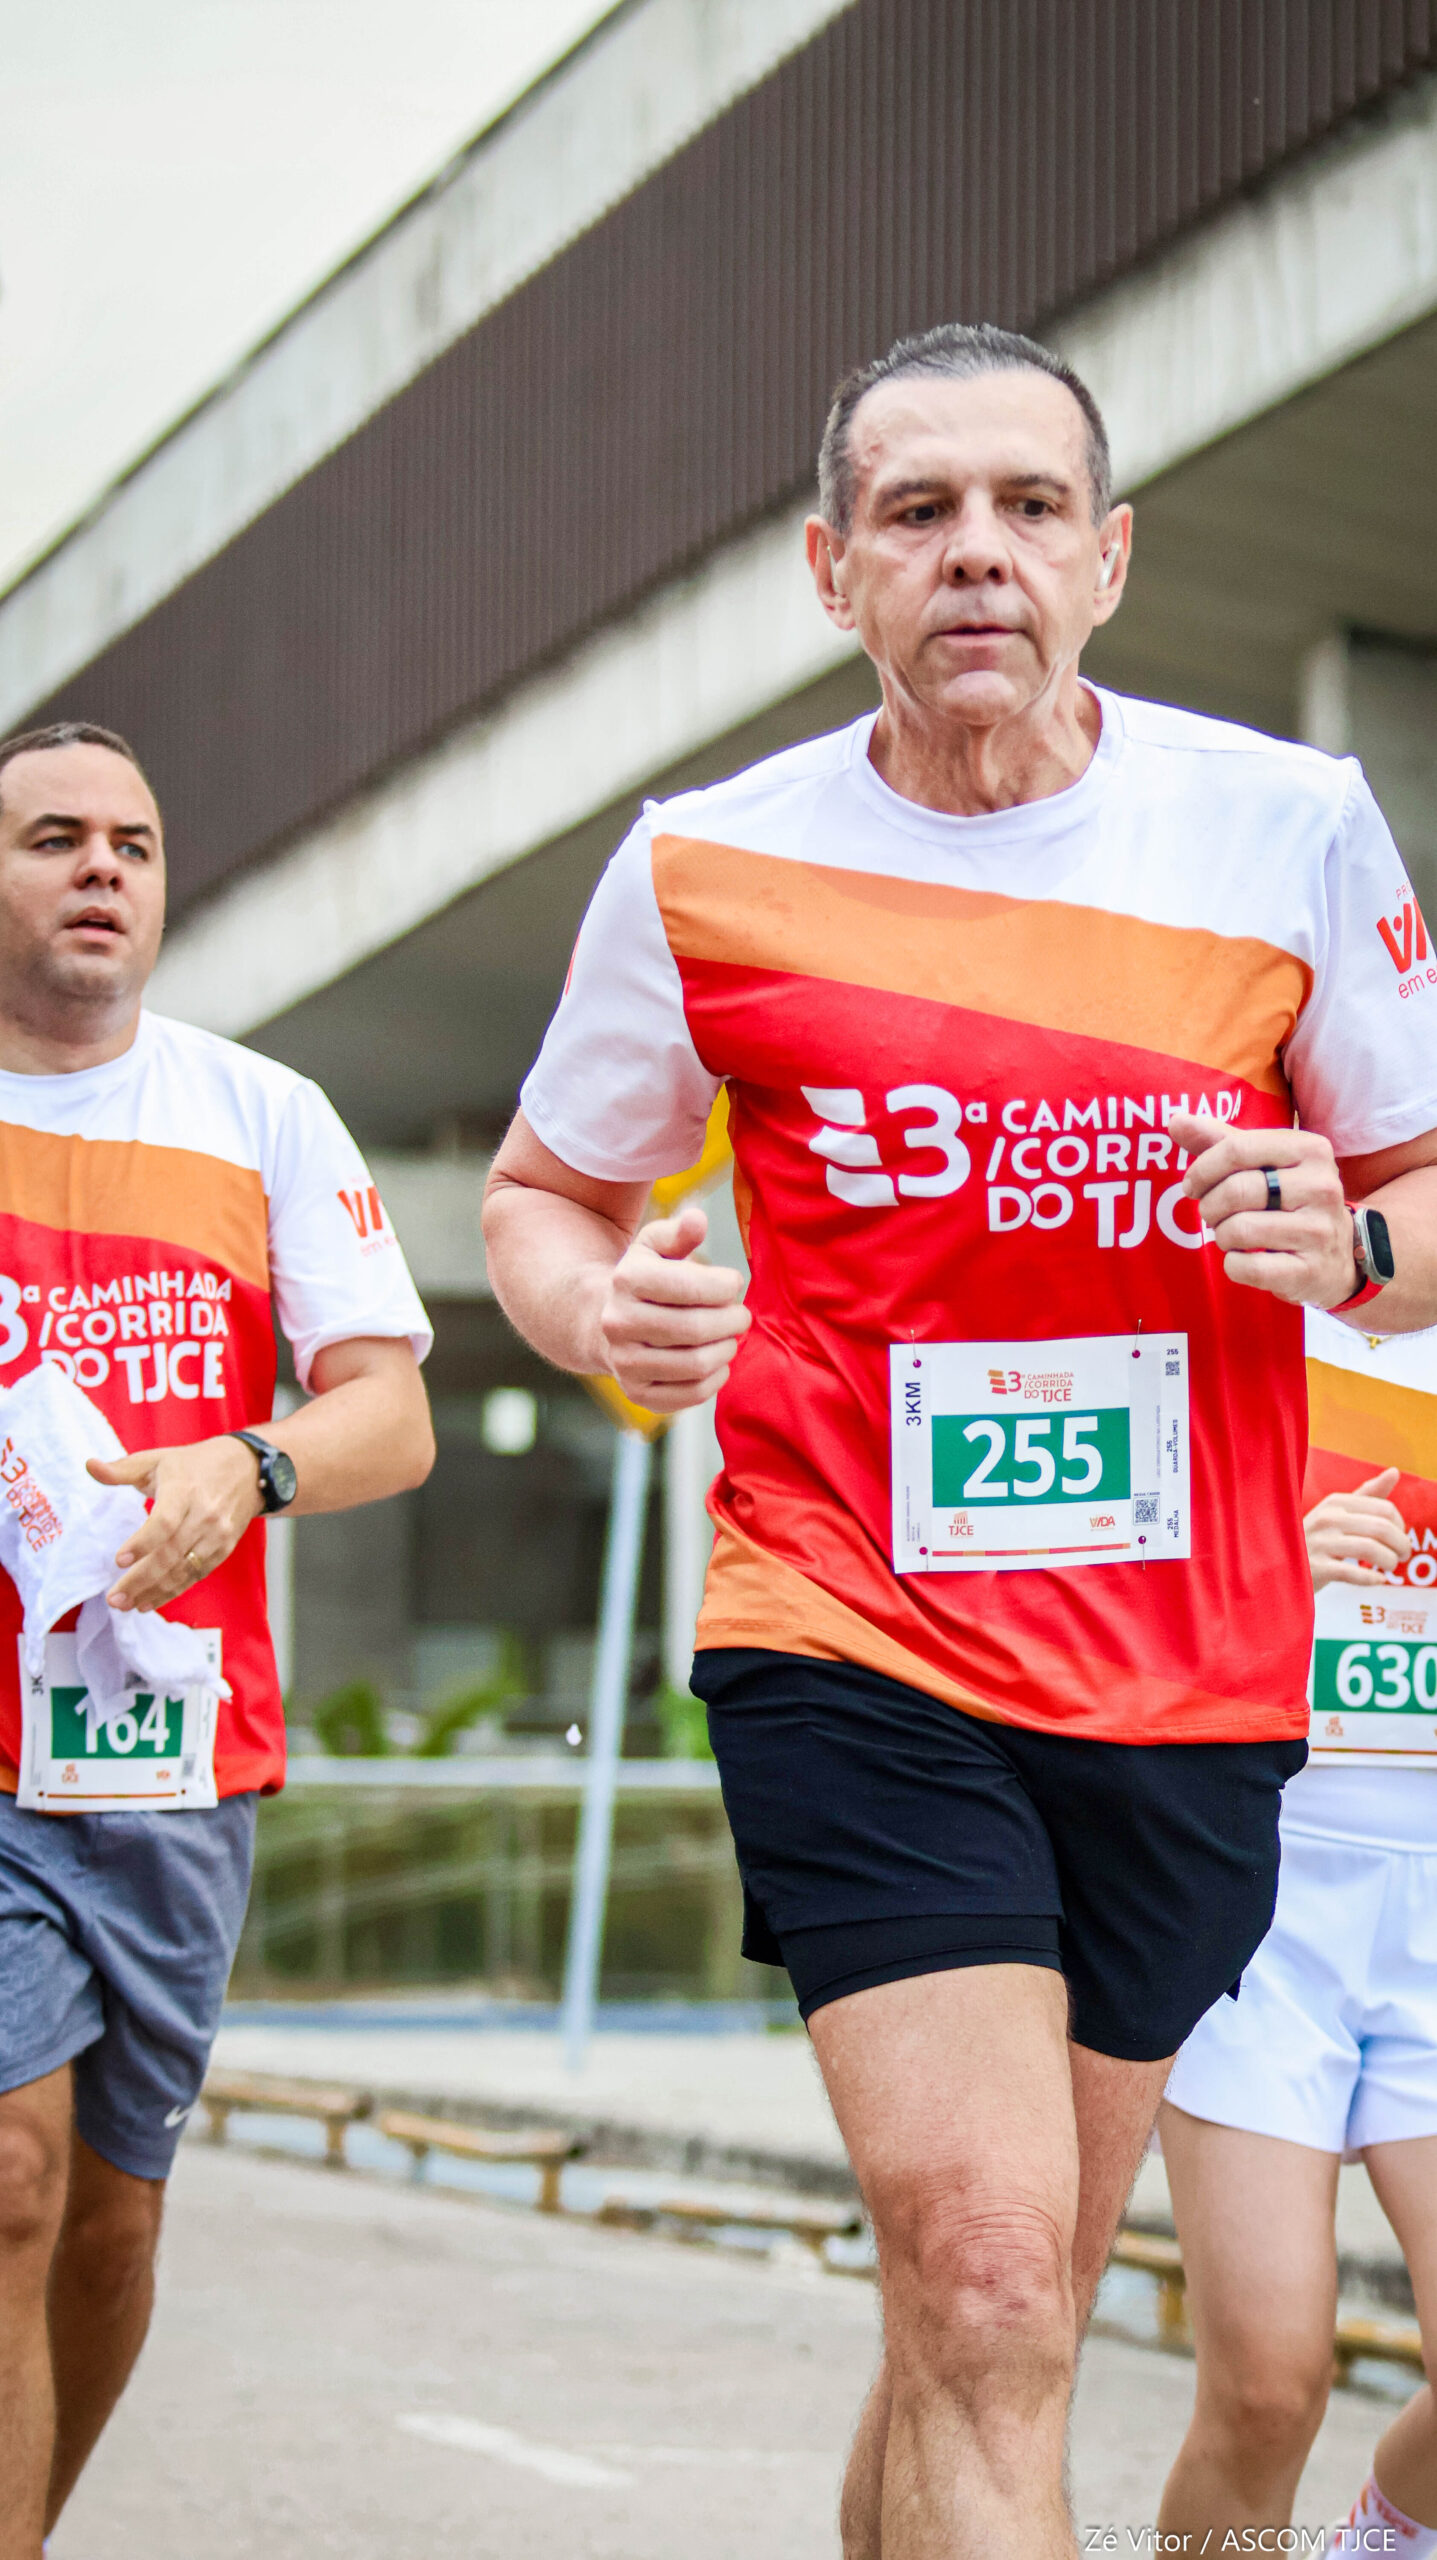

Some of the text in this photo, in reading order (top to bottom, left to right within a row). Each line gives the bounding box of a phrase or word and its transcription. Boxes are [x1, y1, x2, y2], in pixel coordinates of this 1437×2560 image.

[1376, 896, 1427, 974] VI
[1398, 974, 1425, 999] em
[1002, 1089, 1242, 1133] CAMINHADA
[985, 1134, 1189, 1181] /CORRI
[336, 1185, 383, 1238] VI
[988, 1182, 1074, 1232] DO
[50, 1270, 232, 1313] CAMINHADA
[38, 1301, 230, 1348] /CORRIDA
[40, 1341, 226, 1404] DO TJCE
[1166, 1348, 1179, 1356] 255
[1024, 1388, 1072, 1403] DO TJCE
[1027, 1371, 1074, 1381] CAMINHADA
[905, 1382, 921, 1426] 3KM
[962, 1415, 1103, 1499] 255
[18, 1505, 48, 1553] TJCE
[948, 1525, 974, 1536] TJCE
[32, 1674, 44, 1695] 3K
[1336, 1643, 1437, 1710] 630
[74, 1690, 170, 1754] 164
